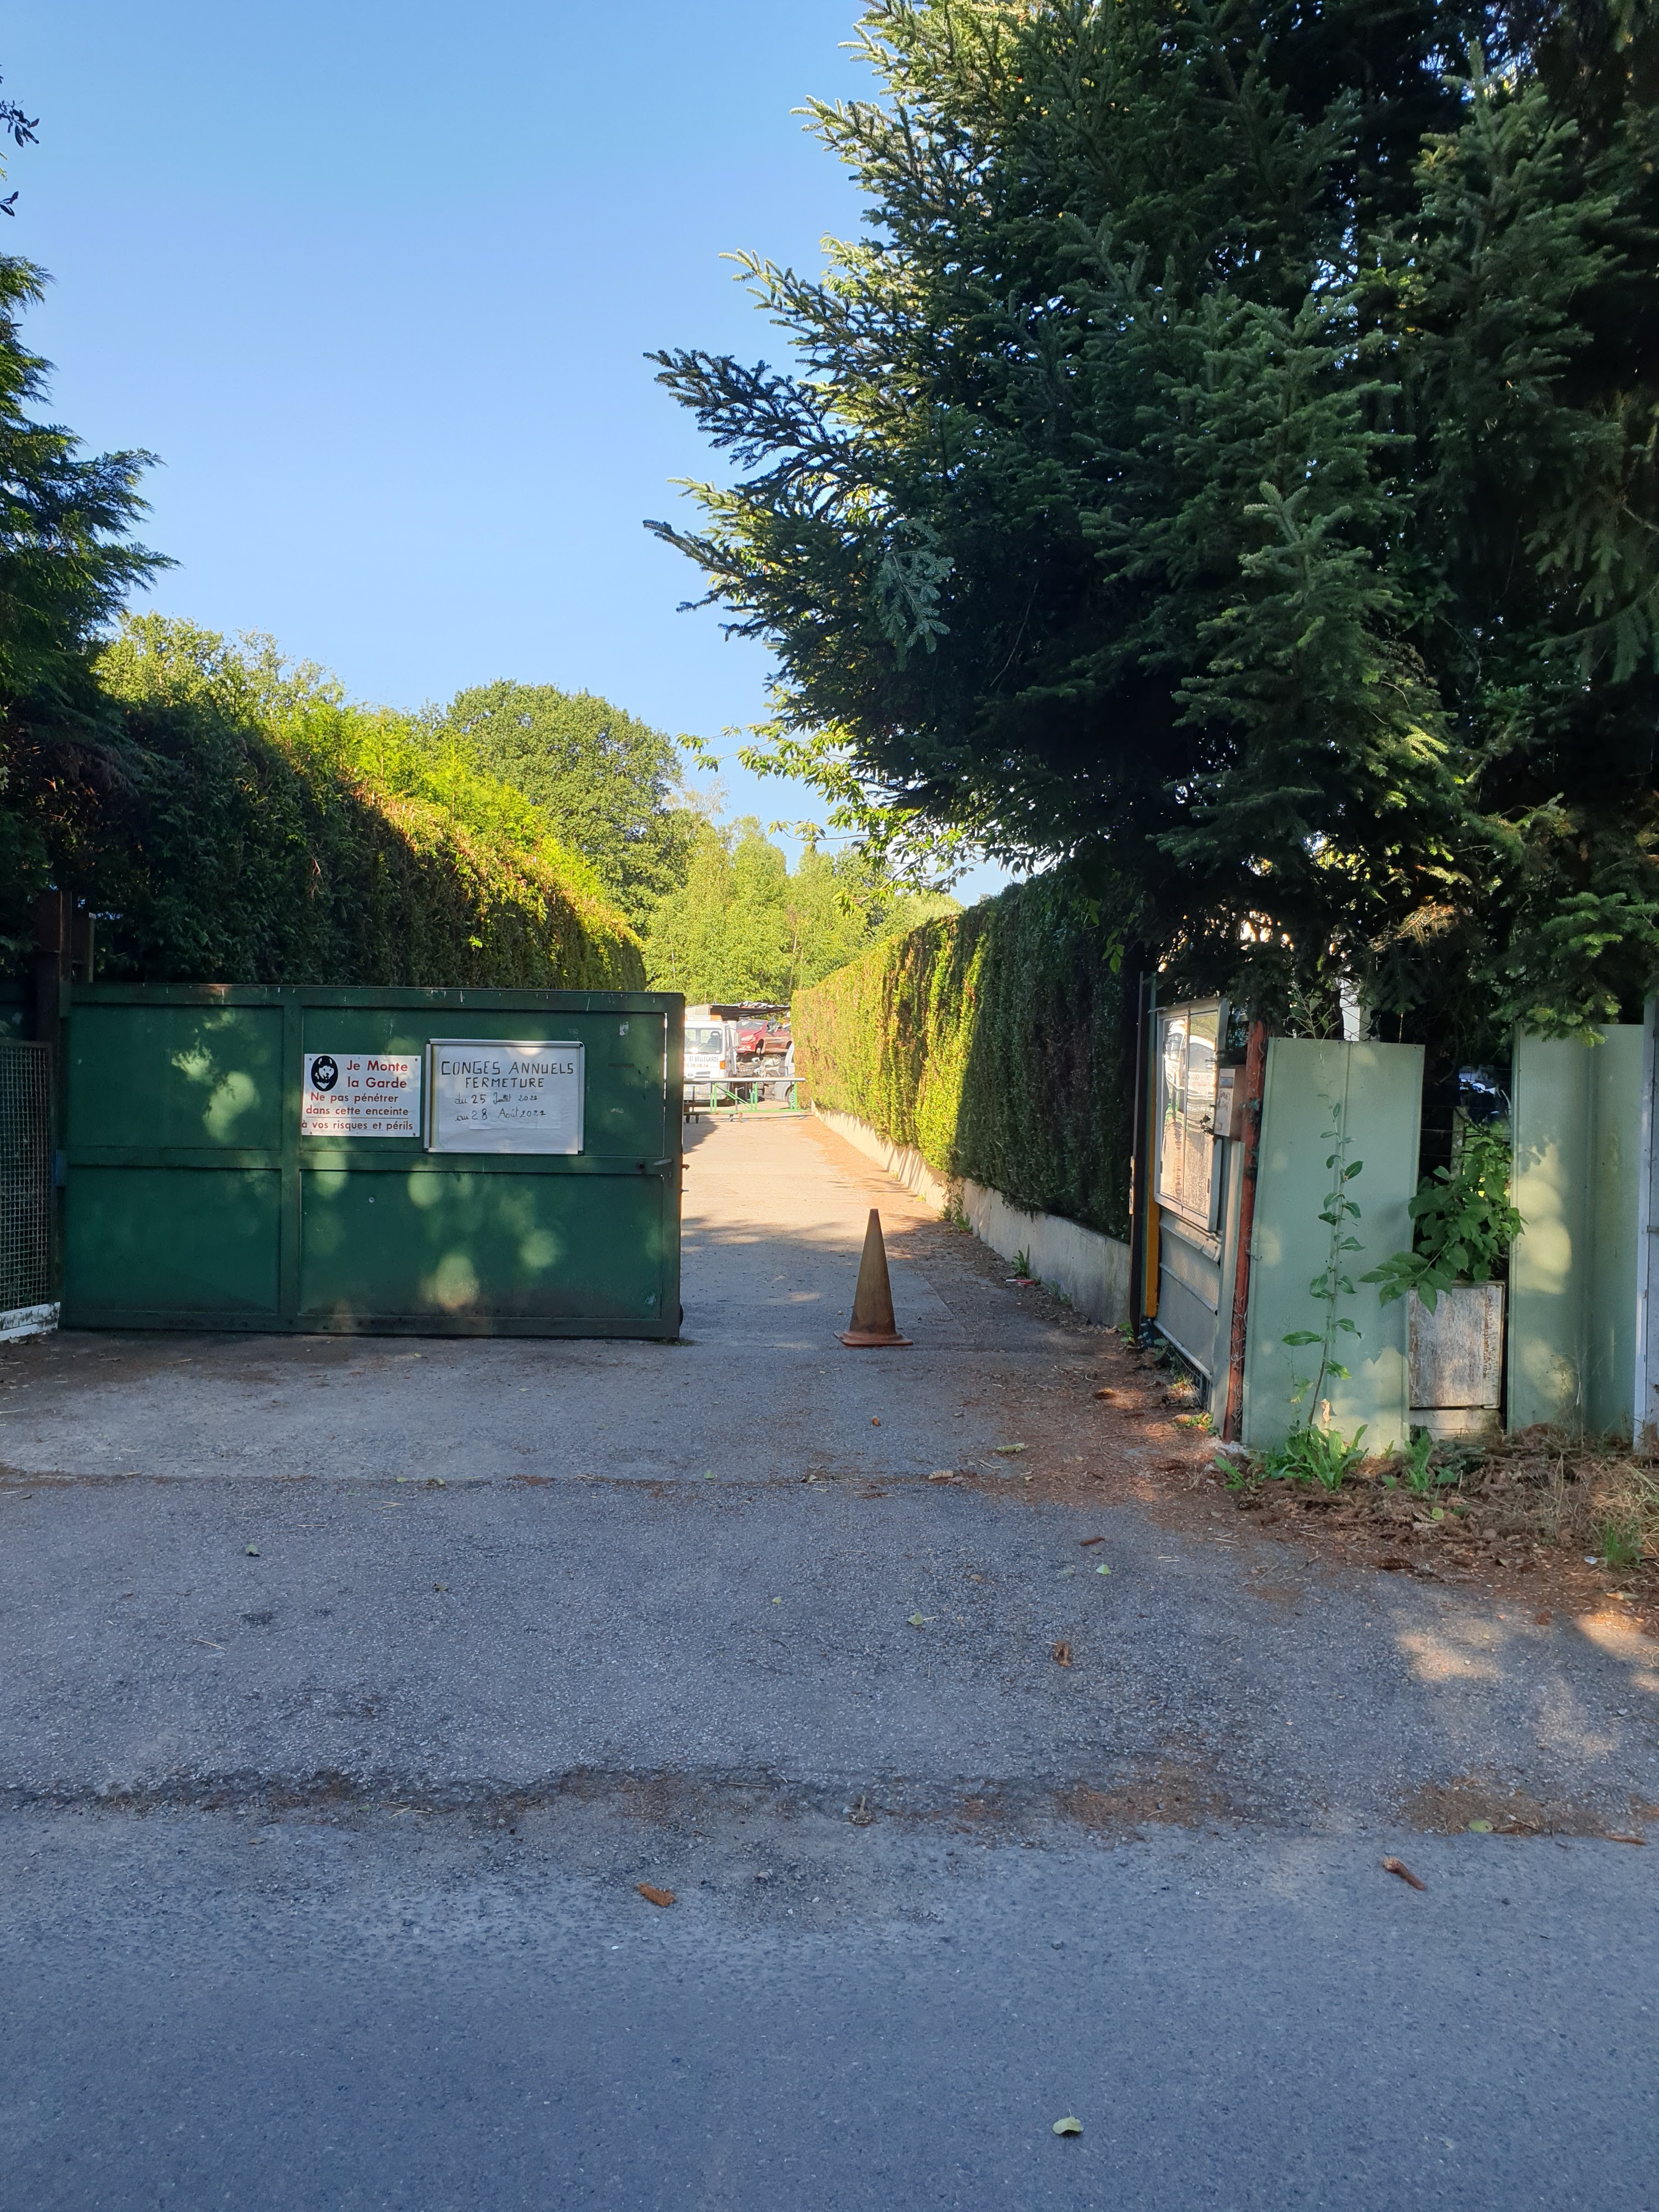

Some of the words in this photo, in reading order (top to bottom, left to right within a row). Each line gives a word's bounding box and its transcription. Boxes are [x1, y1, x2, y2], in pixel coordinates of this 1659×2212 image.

[347, 1060, 360, 1070] Je
[367, 1060, 408, 1071] Monte
[441, 1060, 501, 1075] CONGES
[508, 1062, 574, 1075] ANNUELS
[347, 1076, 359, 1088] la
[365, 1077, 407, 1088] Garde
[465, 1077, 545, 1088] FERMETURE
[311, 1092, 325, 1101] Ne
[330, 1094, 349, 1103] pas
[354, 1093, 399, 1104] pénétrer
[454, 1093, 467, 1104] du
[471, 1094, 487, 1104] 25
[306, 1104, 330, 1115] dans
[335, 1107, 361, 1115] cette
[365, 1107, 409, 1115] enceinte
[471, 1108, 488, 1120] 28
[520, 1109, 547, 1118] 2022
[332, 1120, 368, 1131] risques
[386, 1120, 413, 1131] périls
